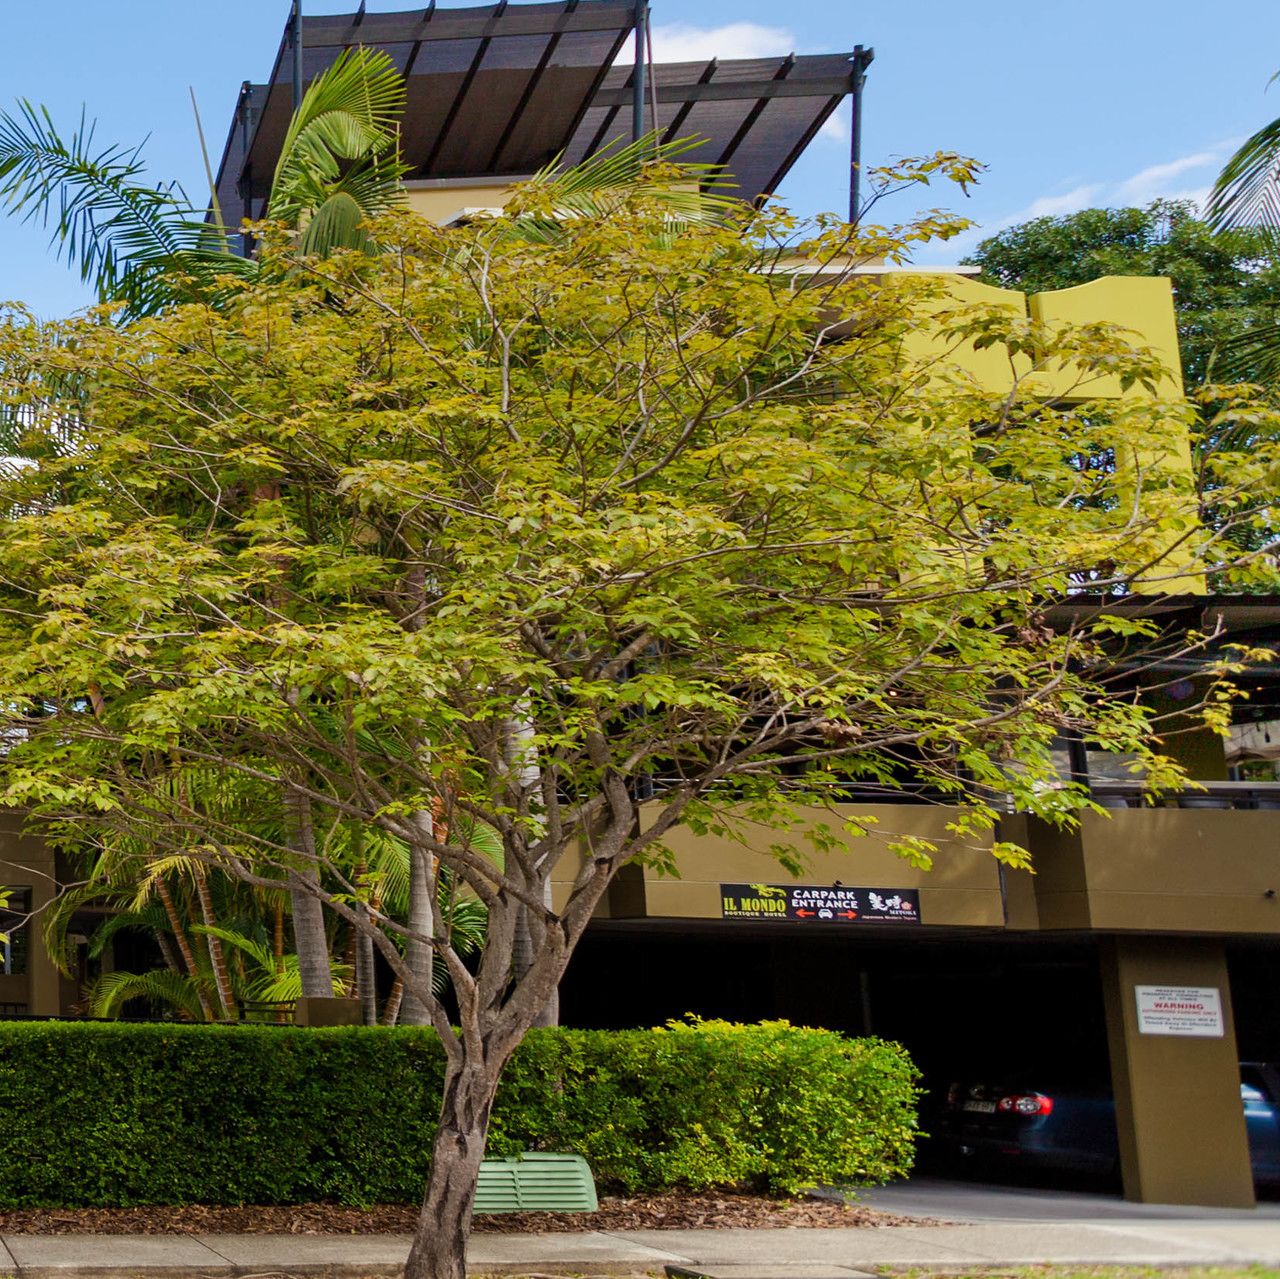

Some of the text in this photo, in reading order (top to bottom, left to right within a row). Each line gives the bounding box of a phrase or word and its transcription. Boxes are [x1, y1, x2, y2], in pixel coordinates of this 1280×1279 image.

[793, 890, 855, 900] CARPARK
[723, 897, 786, 912] IL MONDO
[791, 899, 858, 909] ENTRANCE
[1154, 1002, 1204, 1010] WARNING
